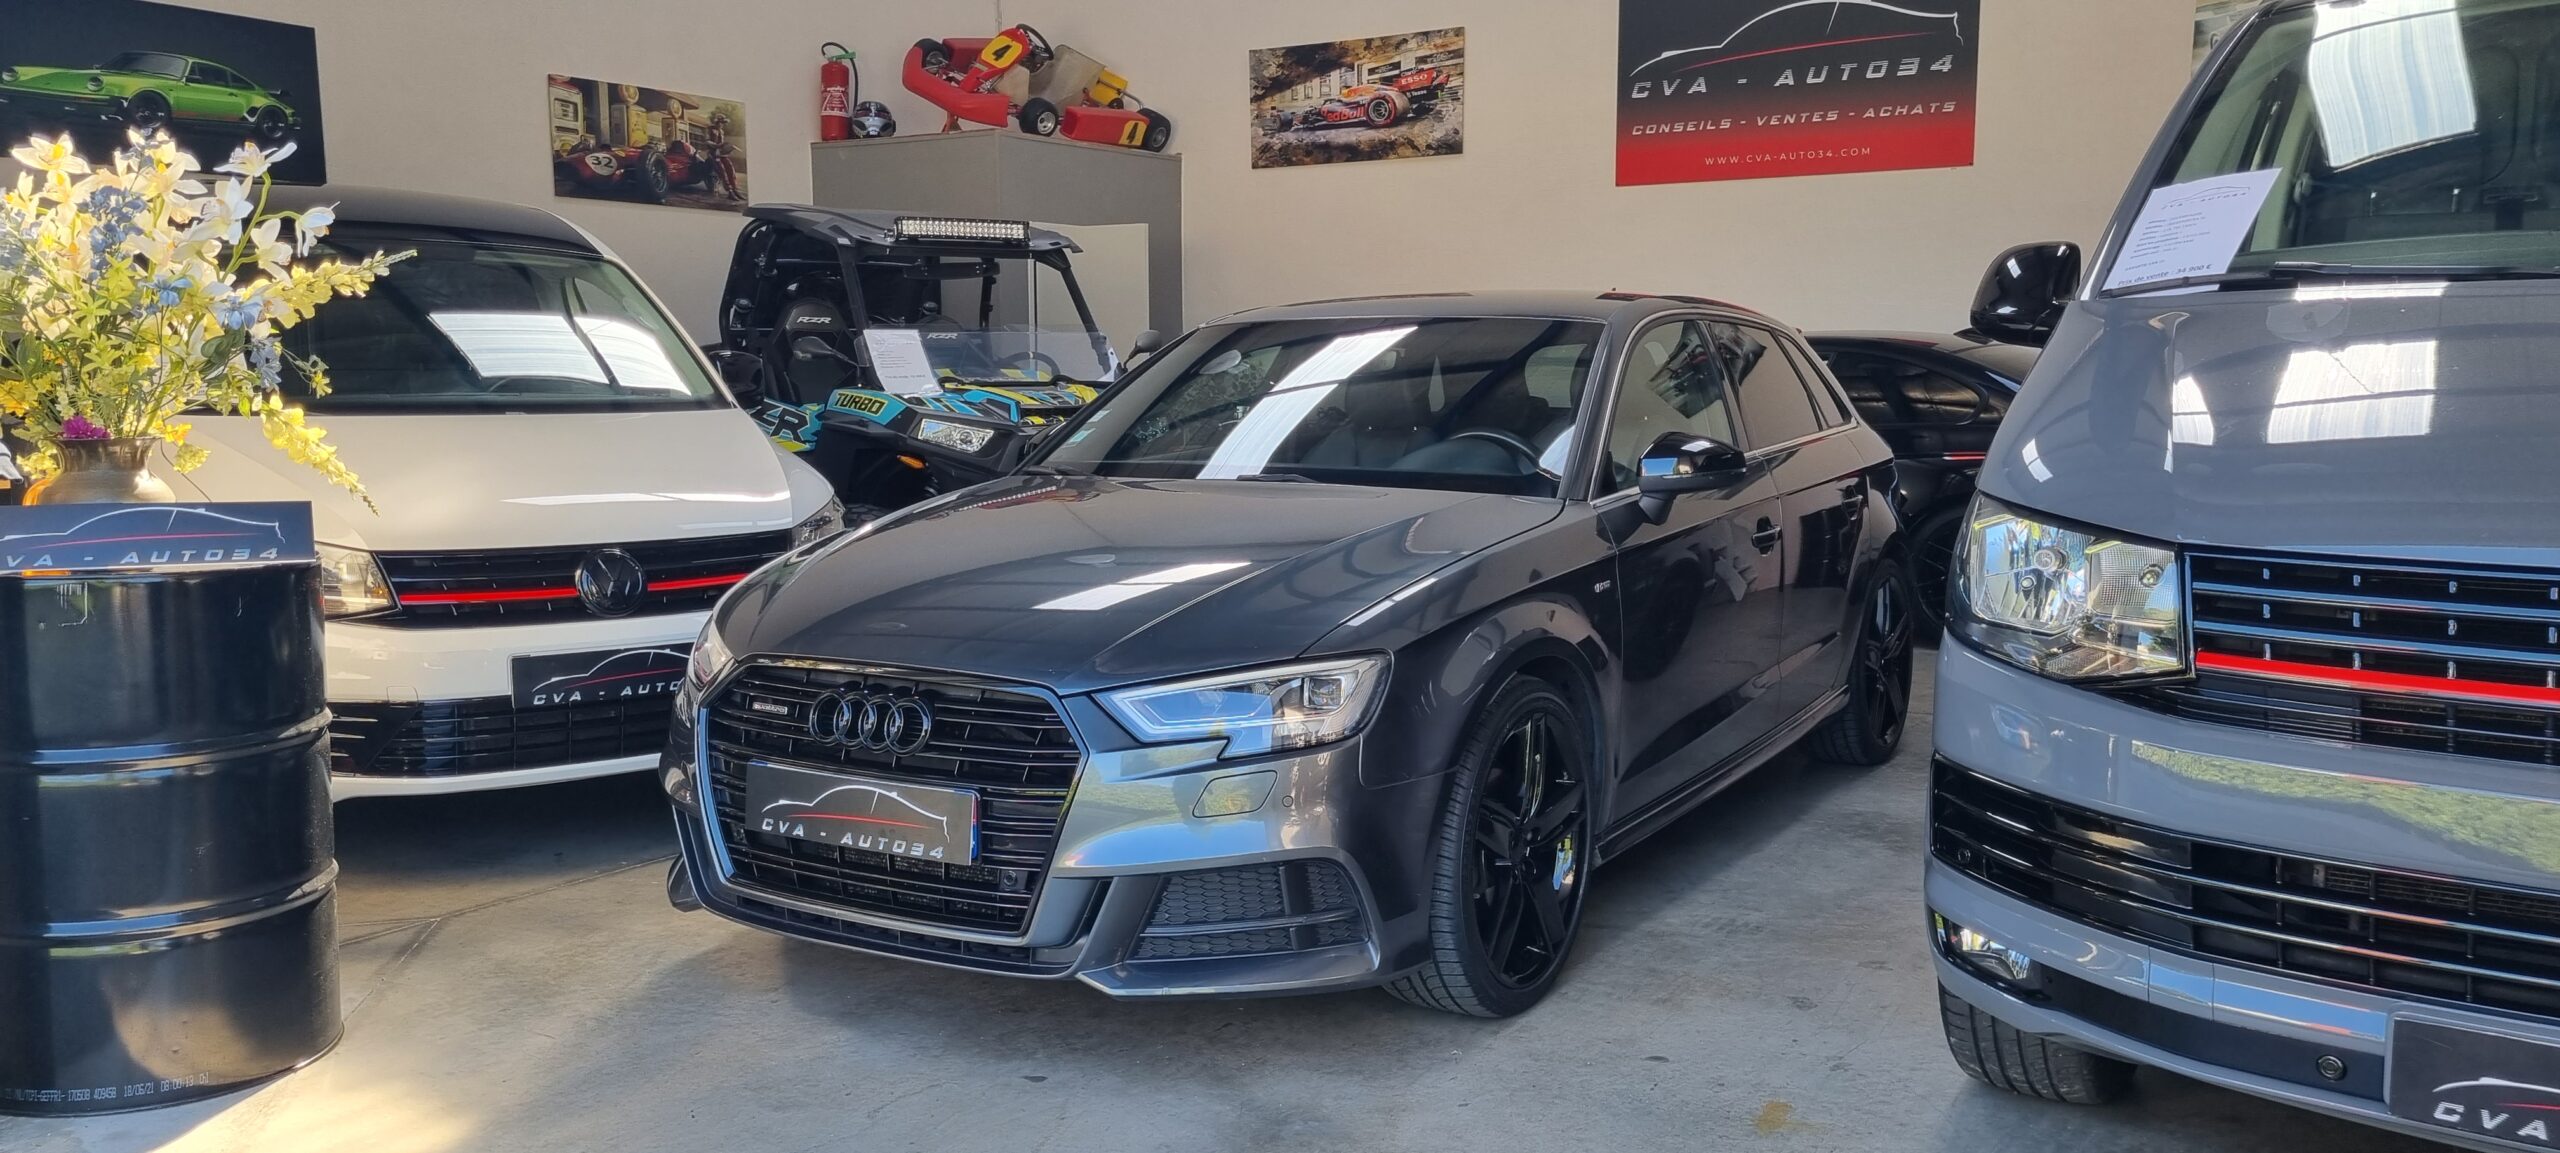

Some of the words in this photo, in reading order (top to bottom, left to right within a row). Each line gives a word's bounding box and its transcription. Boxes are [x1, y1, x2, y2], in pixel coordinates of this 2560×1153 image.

[992, 44, 1013, 62] 4
[1401, 73, 1428, 85] ESSO
[1631, 76, 1708, 99] CVA
[1774, 54, 1955, 88] AUTO34
[1632, 118, 1733, 136] CONSEILS
[1756, 110, 1840, 127] VENTES
[1862, 101, 1958, 118] ACHATS
[1127, 122, 1139, 144] 4
[590, 155, 614, 169] 32
[1704, 147, 1871, 165] WWW.CVA-AUTO34.COM
[796, 316, 832, 324] RZR
[835, 392, 887, 415] TURBO
[119, 547, 279, 565] AUTO34
[532, 690, 582, 705] CVA
[761, 818, 806, 838] CVA
[840, 832, 946, 860] AUTO34
[2433, 1101, 2550, 1141] CVA
